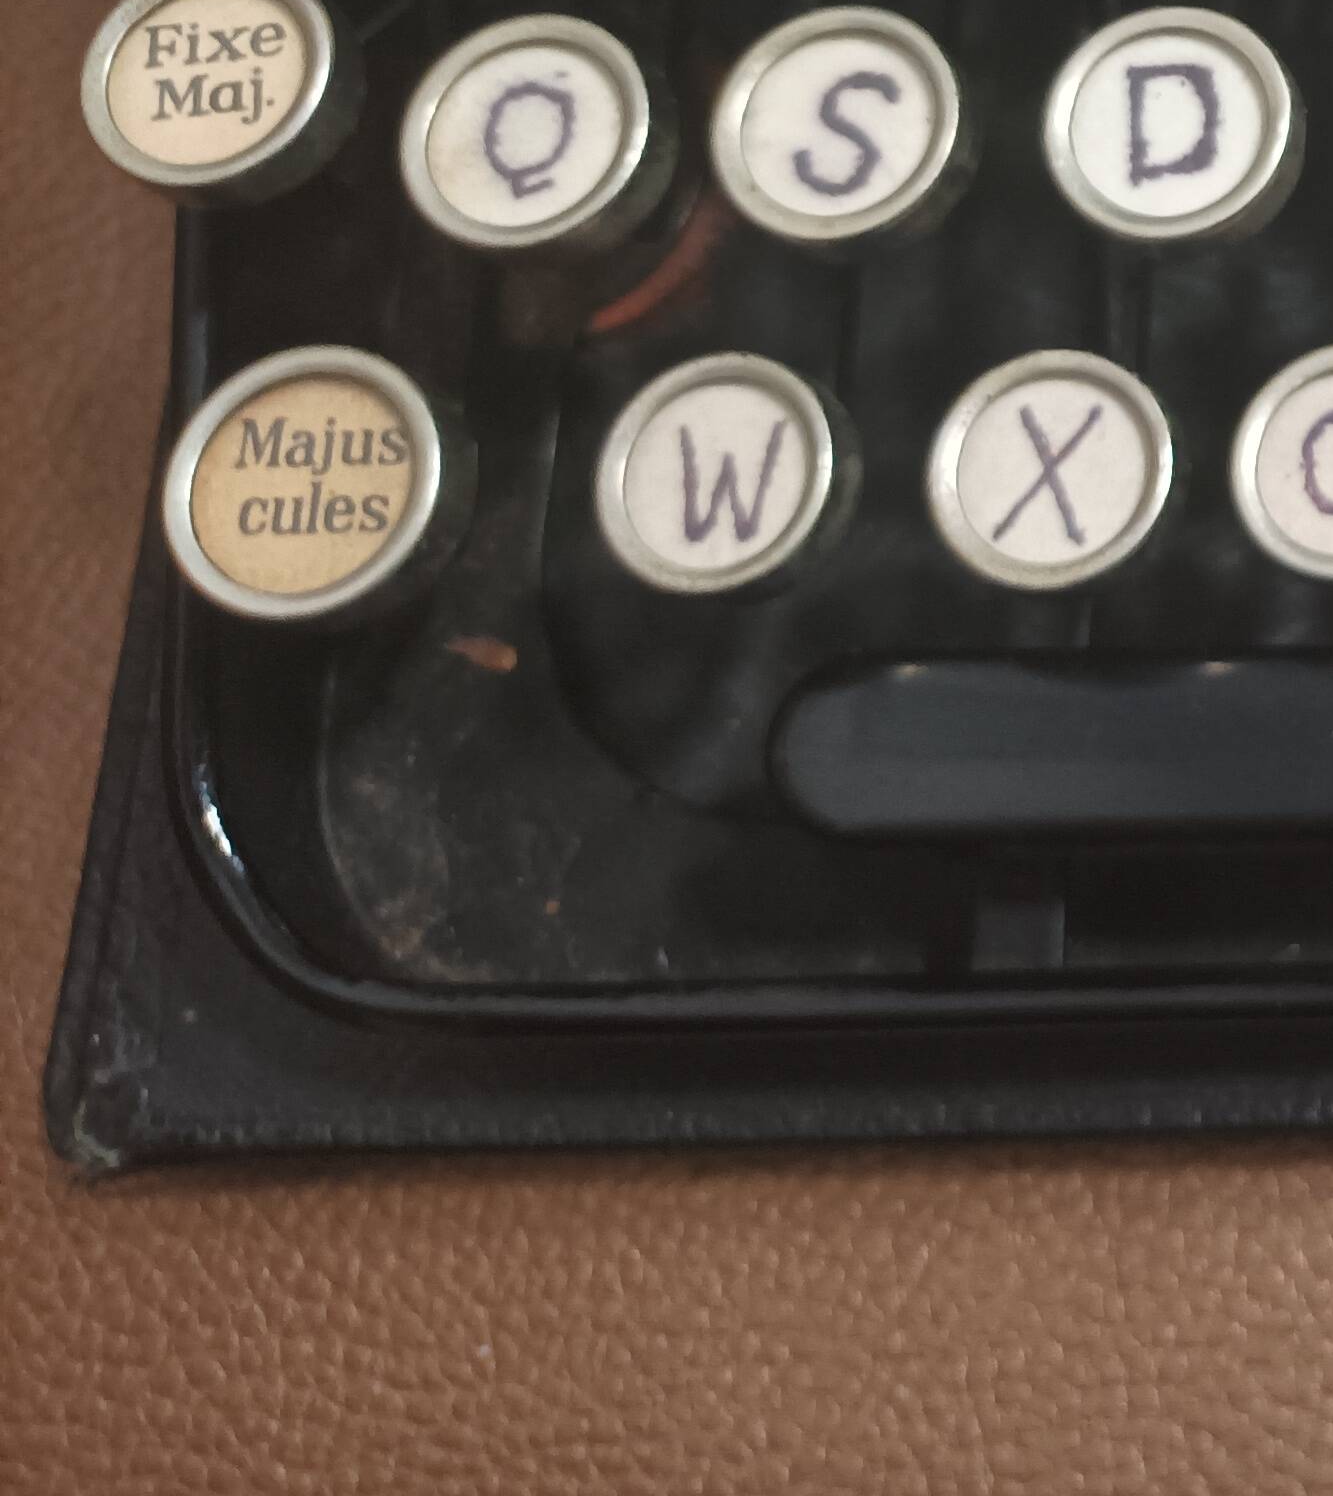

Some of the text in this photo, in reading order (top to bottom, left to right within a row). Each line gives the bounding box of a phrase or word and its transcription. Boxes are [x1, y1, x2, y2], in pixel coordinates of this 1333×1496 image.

[140, 20, 288, 68] Fixe
[150, 74, 277, 126] Maj.
[480, 74, 580, 202] Q
[792, 71, 900, 197] S
[1126, 63, 1221, 187] D
[232, 416, 412, 476] Majus
[679, 421, 786, 543] W
[992, 405, 1102, 546] X
[236, 480, 392, 538] cules
